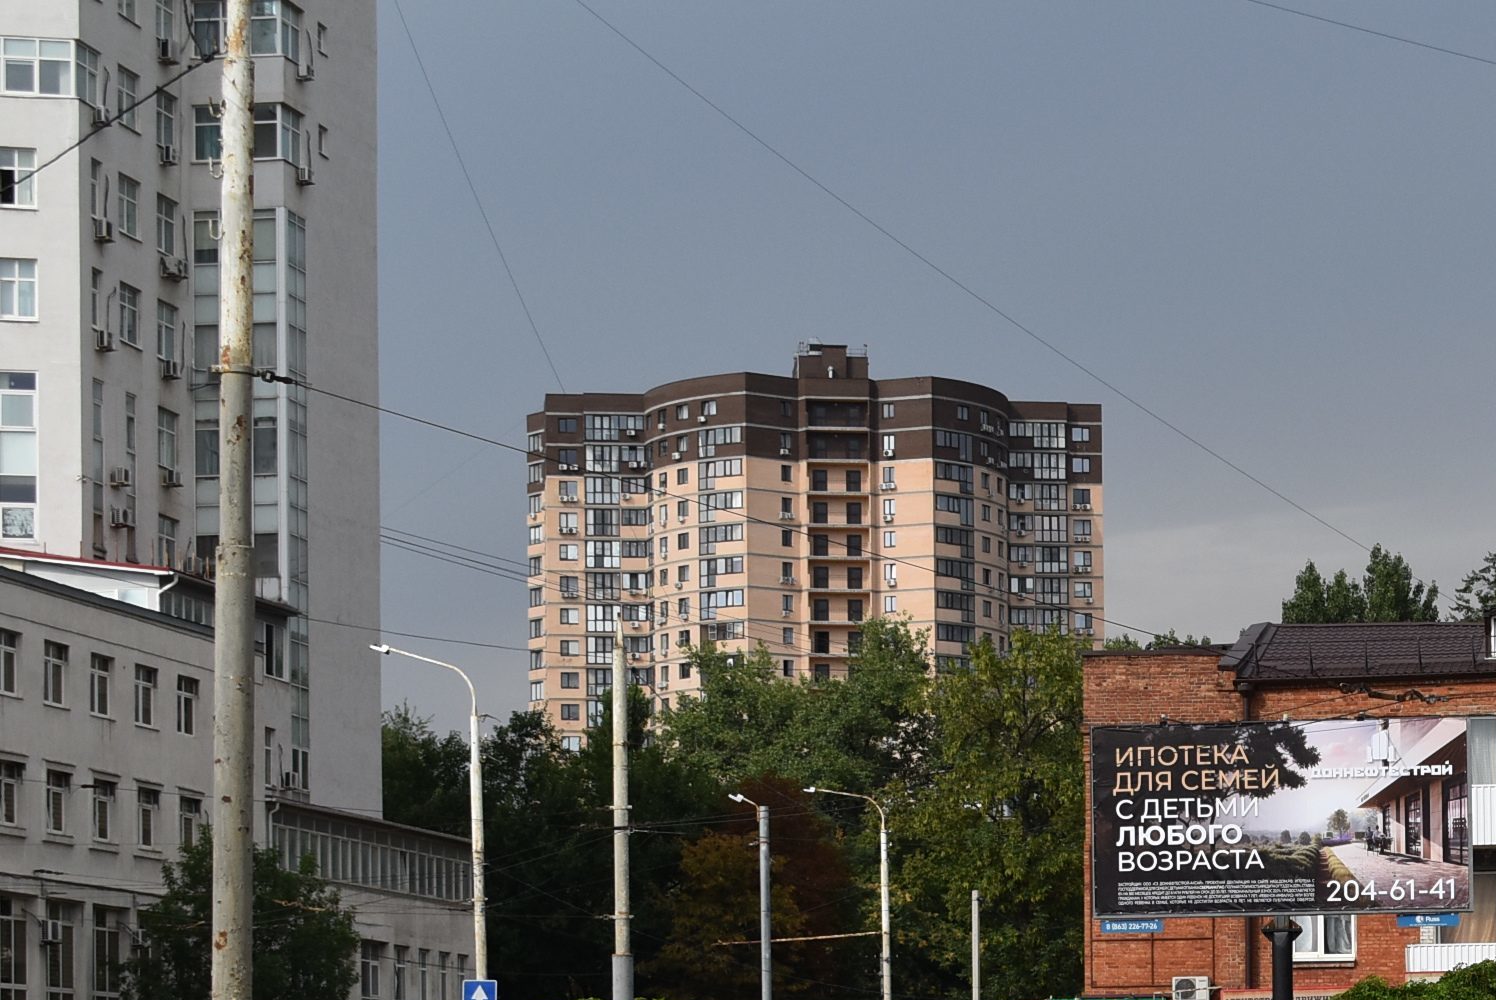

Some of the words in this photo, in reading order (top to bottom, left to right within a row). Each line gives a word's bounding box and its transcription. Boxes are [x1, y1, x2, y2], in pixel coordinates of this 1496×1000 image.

[1115, 744, 1250, 768] ИПОТЕКА
[1112, 770, 1172, 797] ДЛЯ
[1181, 763, 1281, 791] СЕМЕЙ
[1311, 760, 1453, 779] ДОННЕФТЕСТРОЙ
[1115, 799, 1134, 820] С
[1141, 796, 1260, 823] ДЕТЬМИ
[1115, 823, 1243, 847] ЛЮБОГО
[1118, 849, 1265, 873] ВОЗРАСТА
[1326, 878, 1456, 902] 204-61-41
